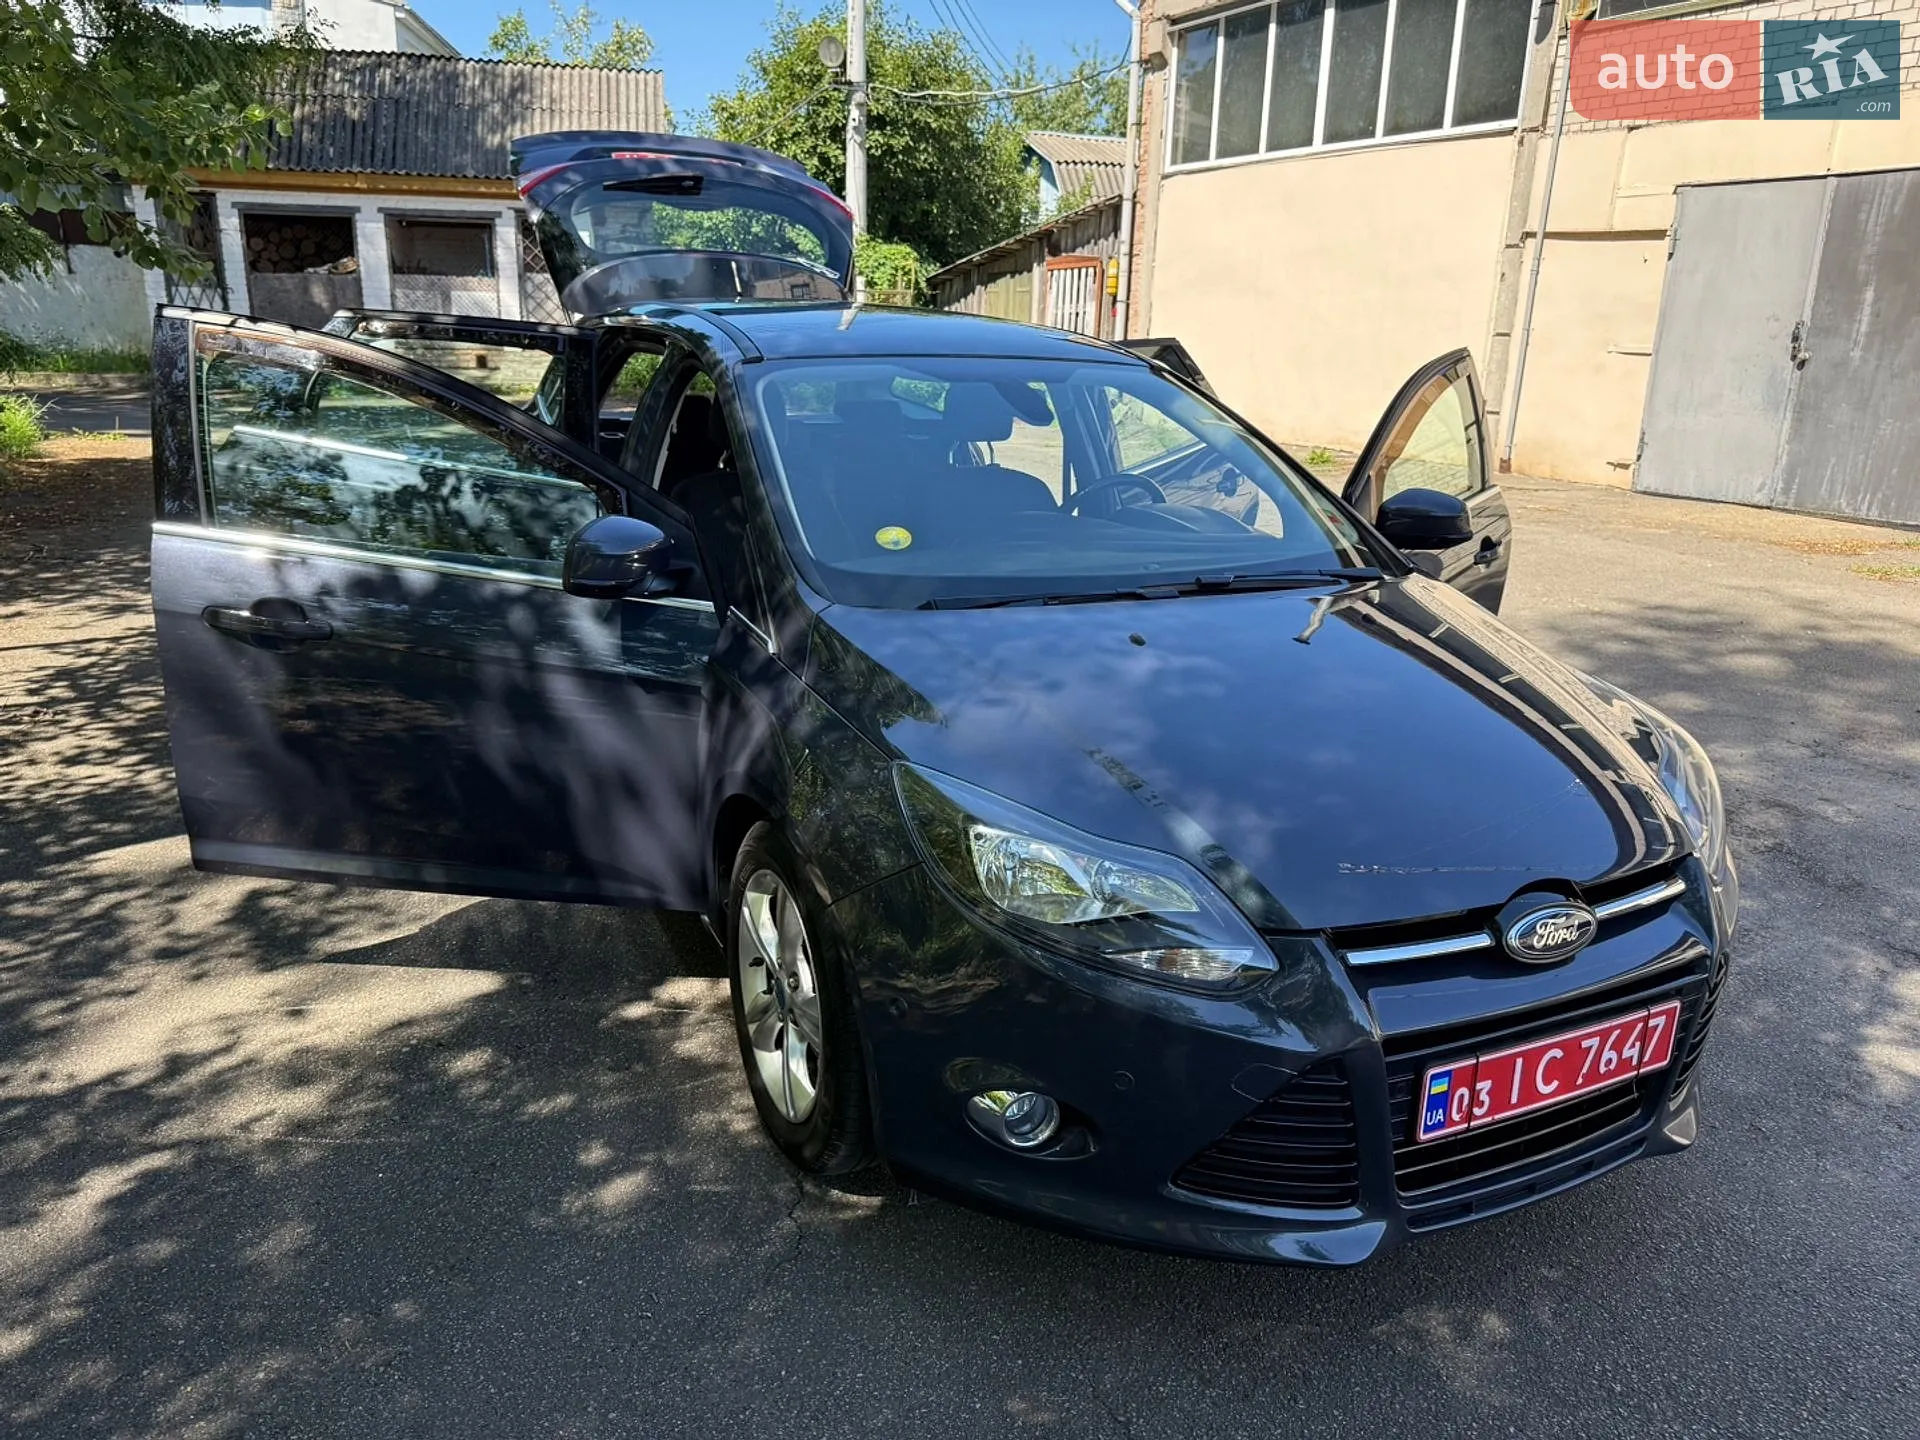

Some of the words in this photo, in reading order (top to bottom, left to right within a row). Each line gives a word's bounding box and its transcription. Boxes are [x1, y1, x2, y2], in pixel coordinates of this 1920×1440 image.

[1533, 916, 1579, 949] Ford
[1451, 1079, 1492, 1122] 03
[1576, 1014, 1668, 1086] 7647
[1426, 1109, 1444, 1126] UA
